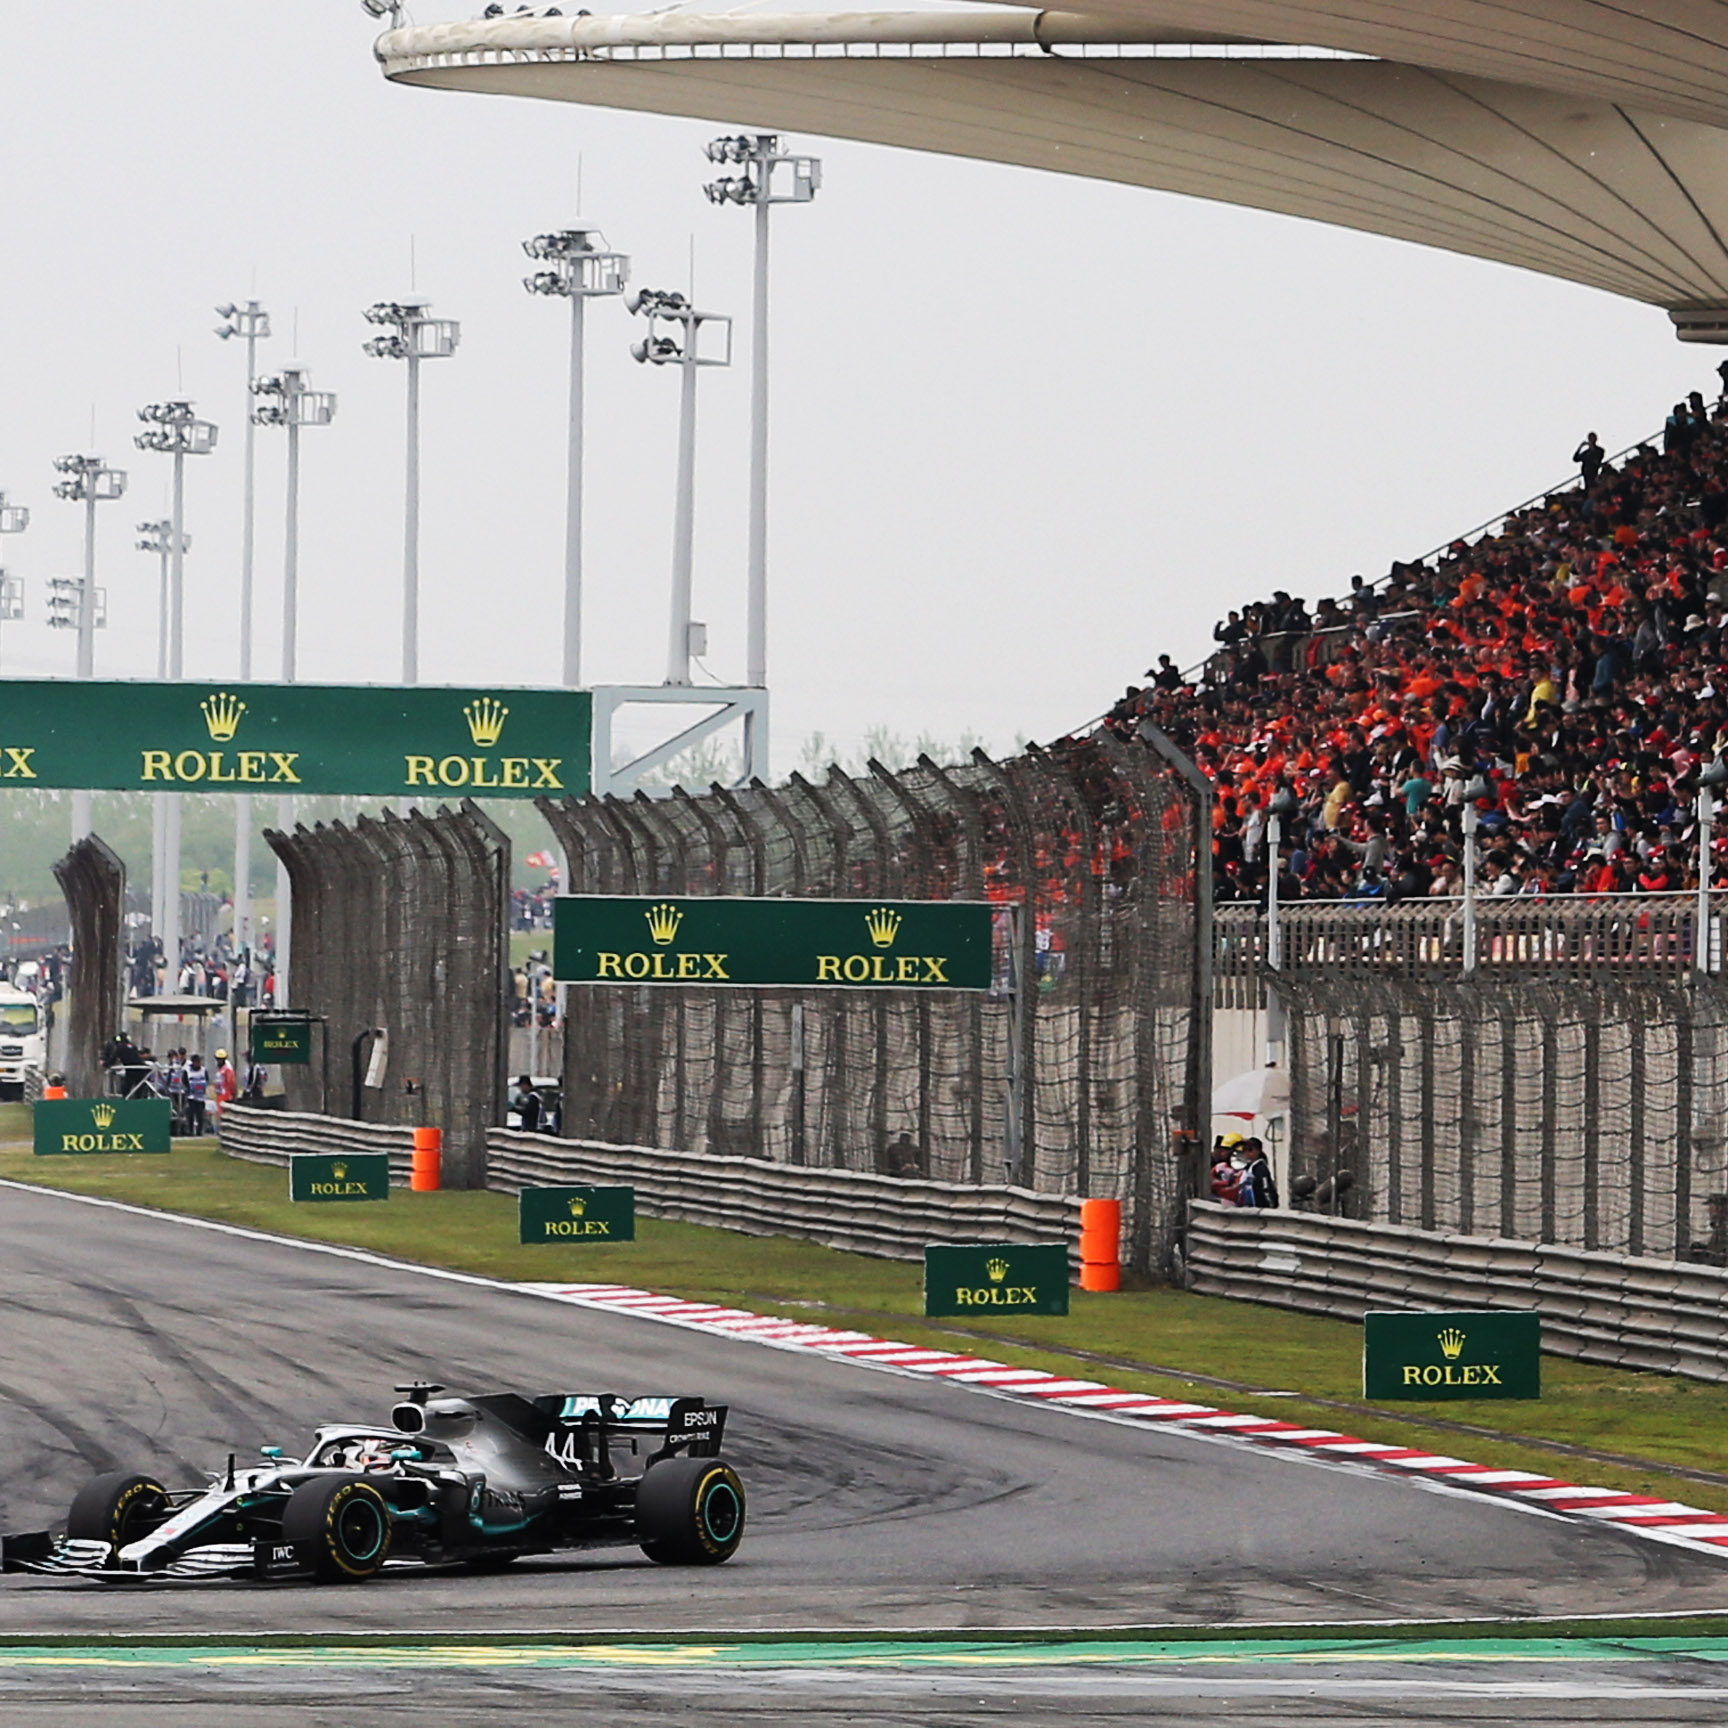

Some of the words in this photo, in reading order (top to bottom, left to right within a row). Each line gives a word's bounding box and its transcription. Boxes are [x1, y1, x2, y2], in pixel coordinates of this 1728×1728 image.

[140, 750, 302, 783] ROLEX
[404, 755, 564, 789] ROLEX
[596, 951, 731, 981] ROLEX
[815, 954, 950, 985] ROLEX
[62, 1133, 143, 1152] ROLEX
[311, 1182, 368, 1195] ROLEX
[545, 1221, 610, 1236] ROLEX
[956, 1286, 1037, 1305] ROLEX
[1402, 1365, 1502, 1386] ROLEX
[684, 1410, 717, 1427] EPSON
[545, 1432, 583, 1472] 44
[272, 1545, 295, 1561] IWC
